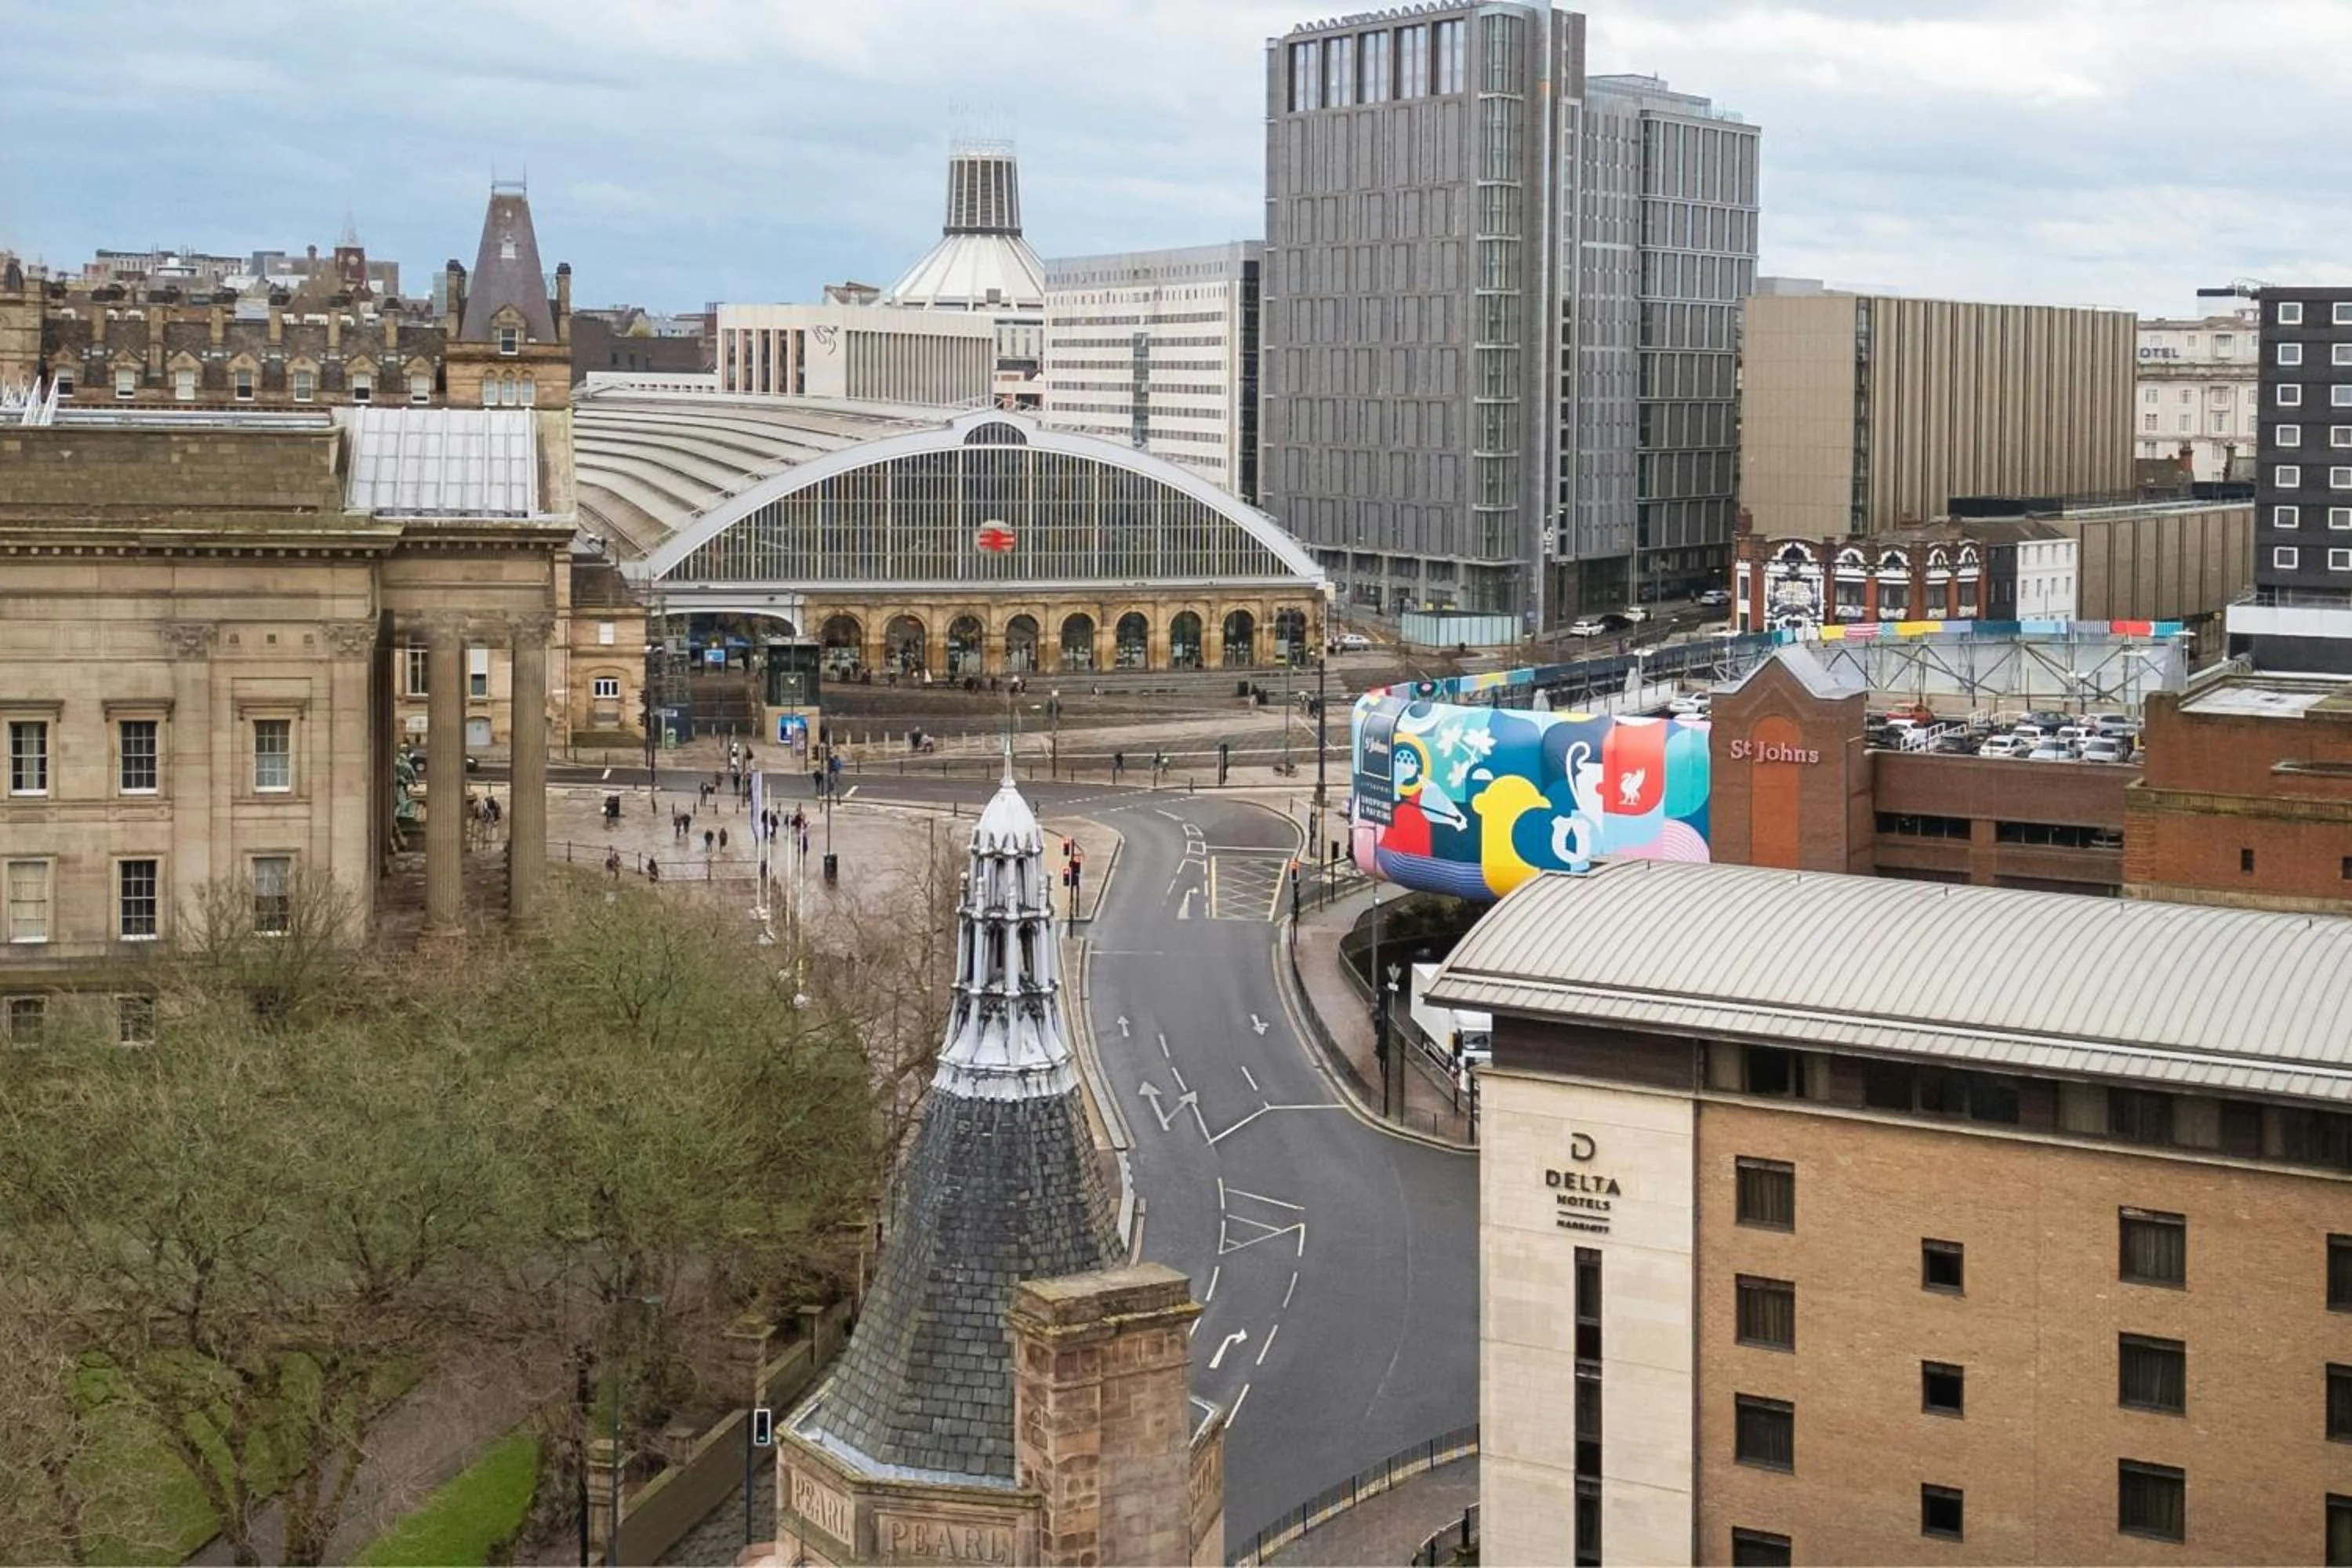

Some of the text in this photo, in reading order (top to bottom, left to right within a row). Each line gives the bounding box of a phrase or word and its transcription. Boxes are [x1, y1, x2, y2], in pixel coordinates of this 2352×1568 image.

[1730, 739, 1820, 764] St Johns
[1545, 1169, 1621, 1196] DELTA
[1556, 1194, 1611, 1211] HOTELS
[793, 1477, 849, 1541] PEARL
[887, 1519, 1007, 1563] PEARL
